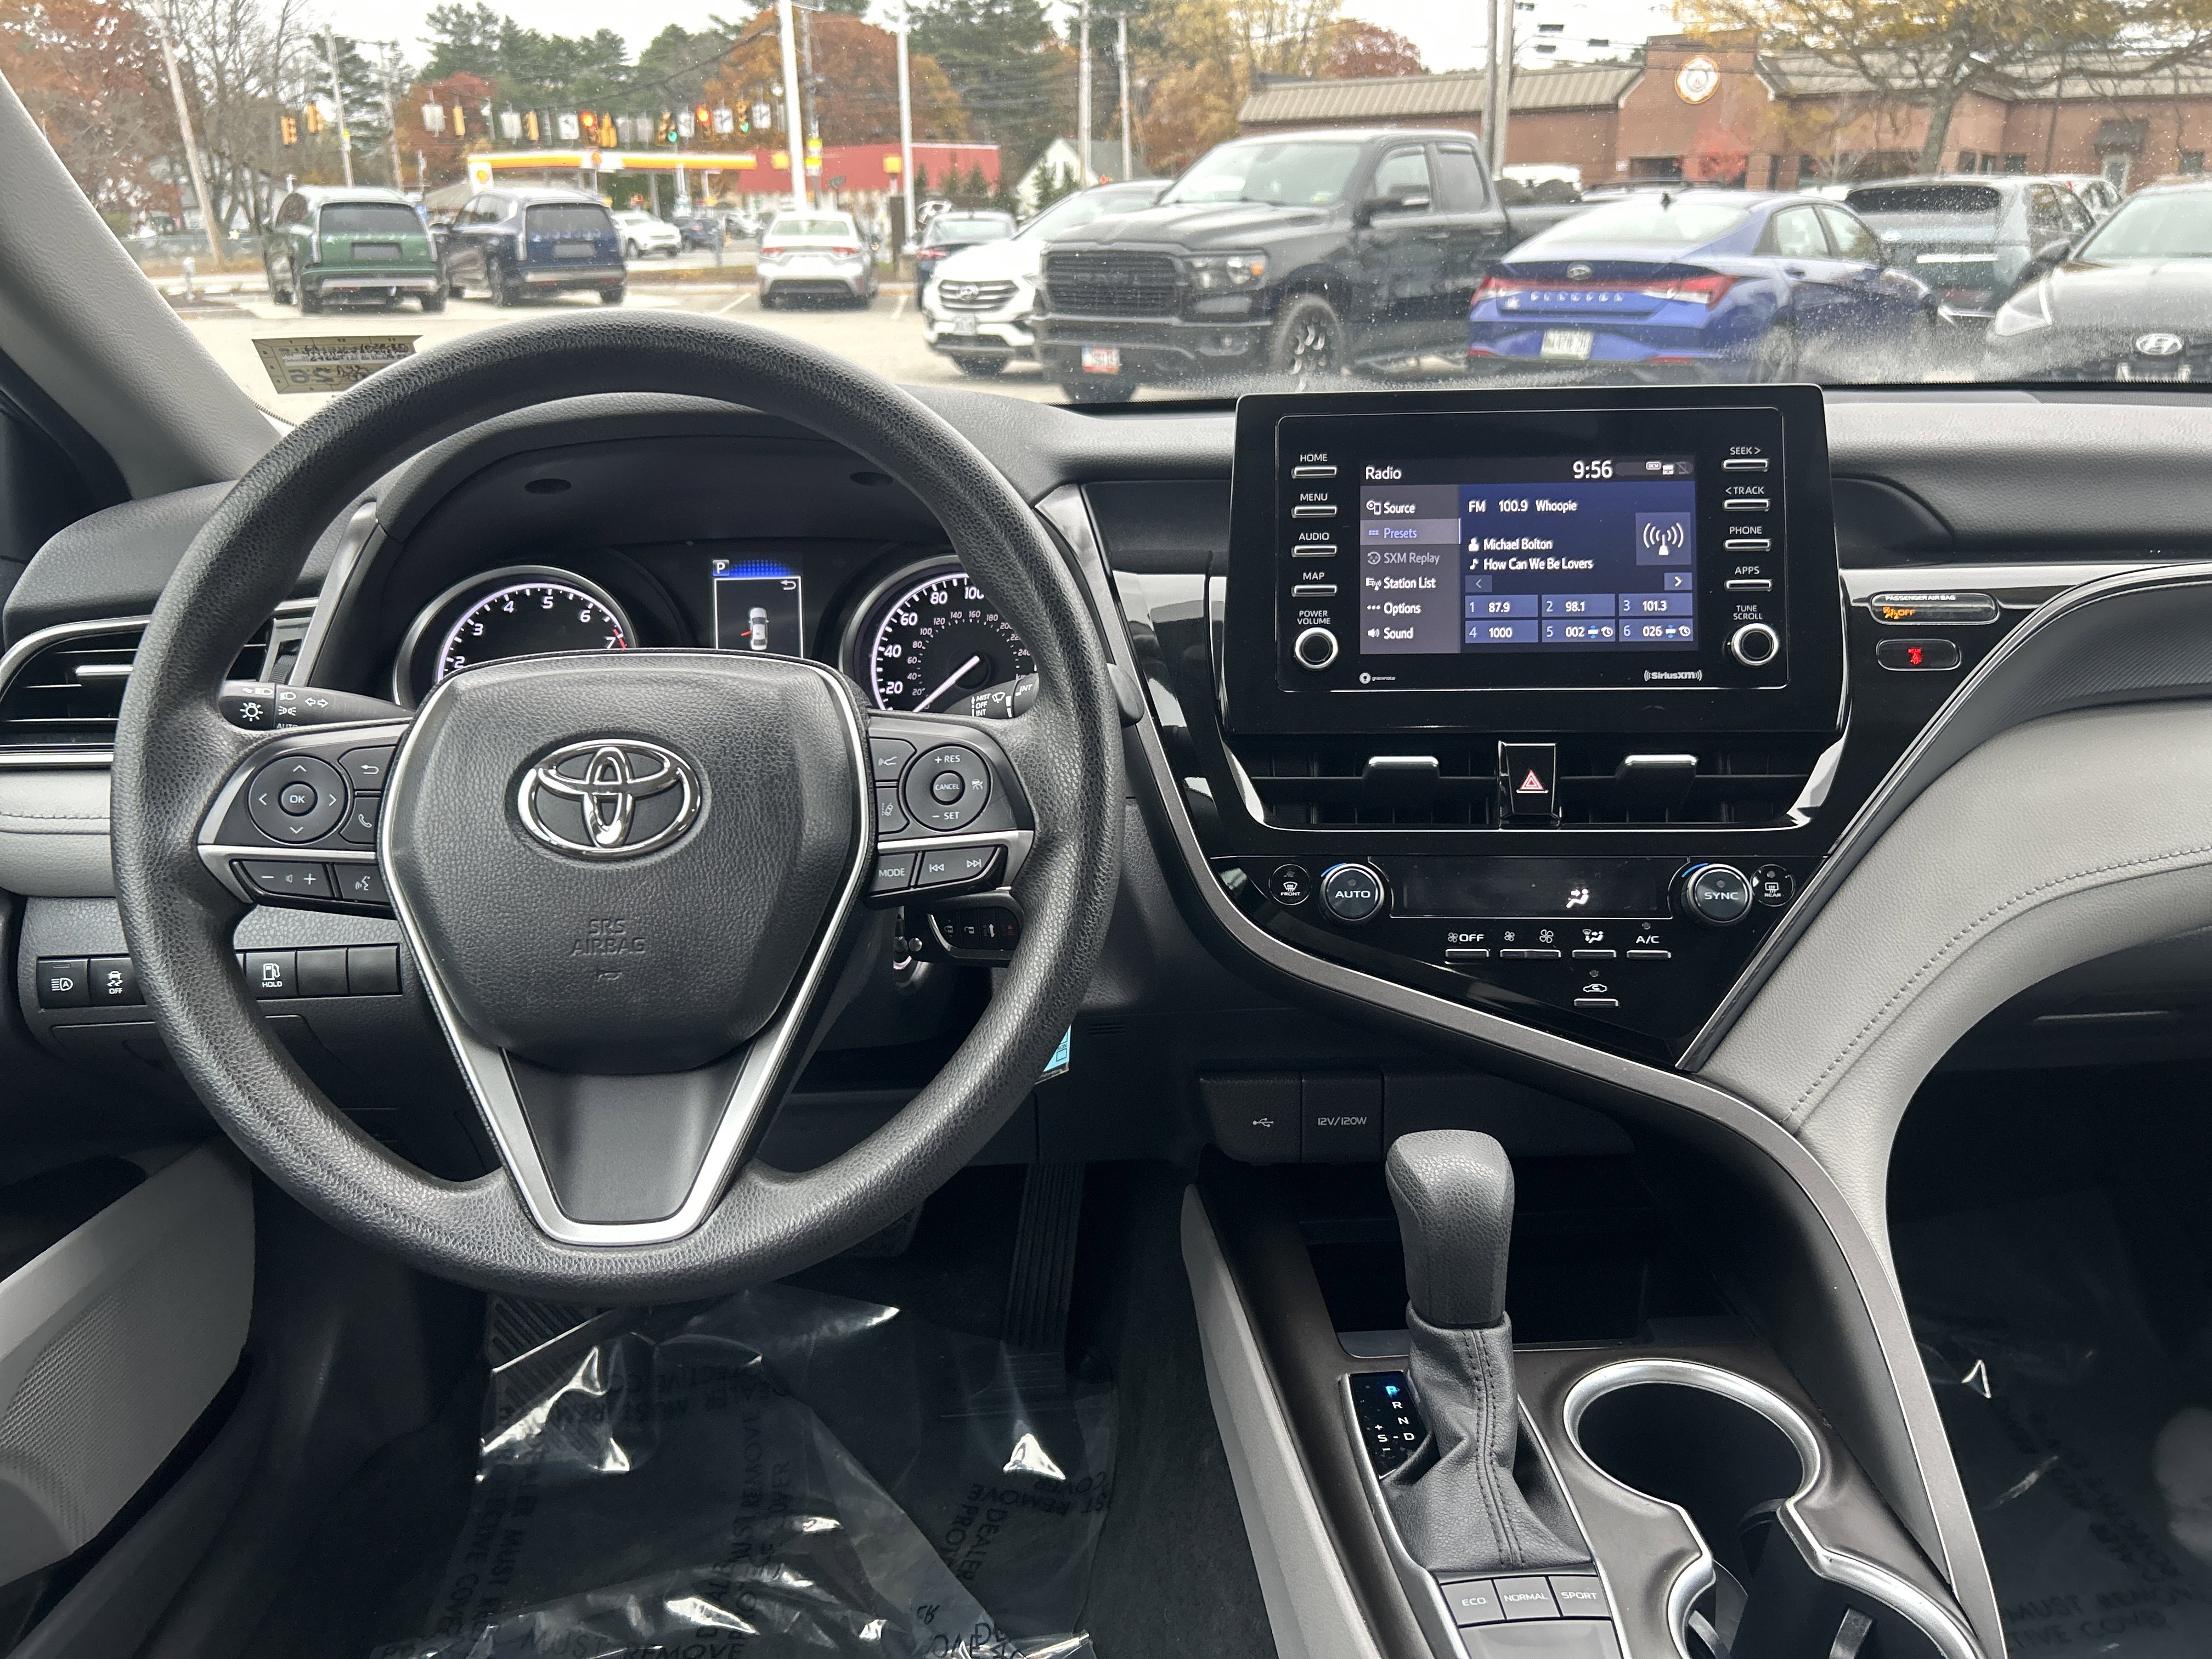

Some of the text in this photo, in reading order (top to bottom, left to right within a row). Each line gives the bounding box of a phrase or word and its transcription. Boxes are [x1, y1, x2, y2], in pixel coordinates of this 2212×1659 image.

[1730, 446, 1753, 455] SEEK
[1300, 453, 1328, 462] HOME
[1365, 466, 1402, 480] Radio
[1573, 461, 1612, 479] 9:56
[1733, 486, 1765, 495] TRACK
[1300, 493, 1328, 502] MENU
[1383, 501, 1415, 515] Source
[1468, 500, 1578, 513] FM 100.9 Whoopie
[1383, 527, 1418, 540] Presets
[1729, 526, 1763, 535] PHONE
[1299, 532, 1330, 541] AUDIO
[1483, 538, 1553, 550] Michael Bolton
[1383, 552, 1440, 566] SXM Replay
[1483, 558, 1594, 570] How Can We Be Lovers
[716, 561, 726, 574] P
[1734, 566, 1760, 575] APPS
[1302, 572, 1325, 580] MAP
[1383, 577, 1436, 590] Station List
[543, 596, 554, 609] 5
[930, 591, 948, 605] 80
[503, 600, 514, 613] 4
[1383, 602, 1421, 616] Options
[1469, 602, 1510, 613] 1 87.9
[1546, 601, 1585, 612] 2 98.1
[1623, 601, 1667, 612] 3 101.3
[579, 610, 591, 623] 6
[900, 613, 918, 626] 60
[1297, 618, 1331, 626] VOLUME
[1732, 612, 1764, 621] SCROLL
[473, 623, 484, 636] 3
[1383, 627, 1414, 640] Sound
[1469, 627, 1513, 639] 4 1000
[1546, 627, 1585, 638] 5 002
[1623, 626, 1663, 637] 6 026
[604, 636, 616, 649] 7
[884, 645, 901, 658] 40
[454, 656, 466, 669] 2
[885, 681, 903, 695] 20
[1020, 684, 1032, 692] INT
[976, 693, 991, 701] MIST
[944, 754, 960, 763] RES
[935, 783, 960, 791] CANCEL
[290, 795, 305, 804] OK
[944, 811, 959, 821] SET
[879, 867, 905, 878] MODE
[1335, 890, 1371, 899] AUTO
[1703, 891, 1739, 900] SYNC
[589, 918, 627, 936] SRS
[1458, 933, 1484, 942] OFF
[1636, 934, 1660, 945] A/C
[565, 936, 646, 957] AIRBAG
[1317, 1116, 1367, 1126] 12V/120W
[1386, 1386, 1400, 1396] P
[1397, 1417, 1409, 1425] N
[1377, 1432, 1415, 1442] S D
[956, 1509, 1009, 1581] DEALER
[1461, 1592, 1598, 1607] ECO NORMAL SPORT
